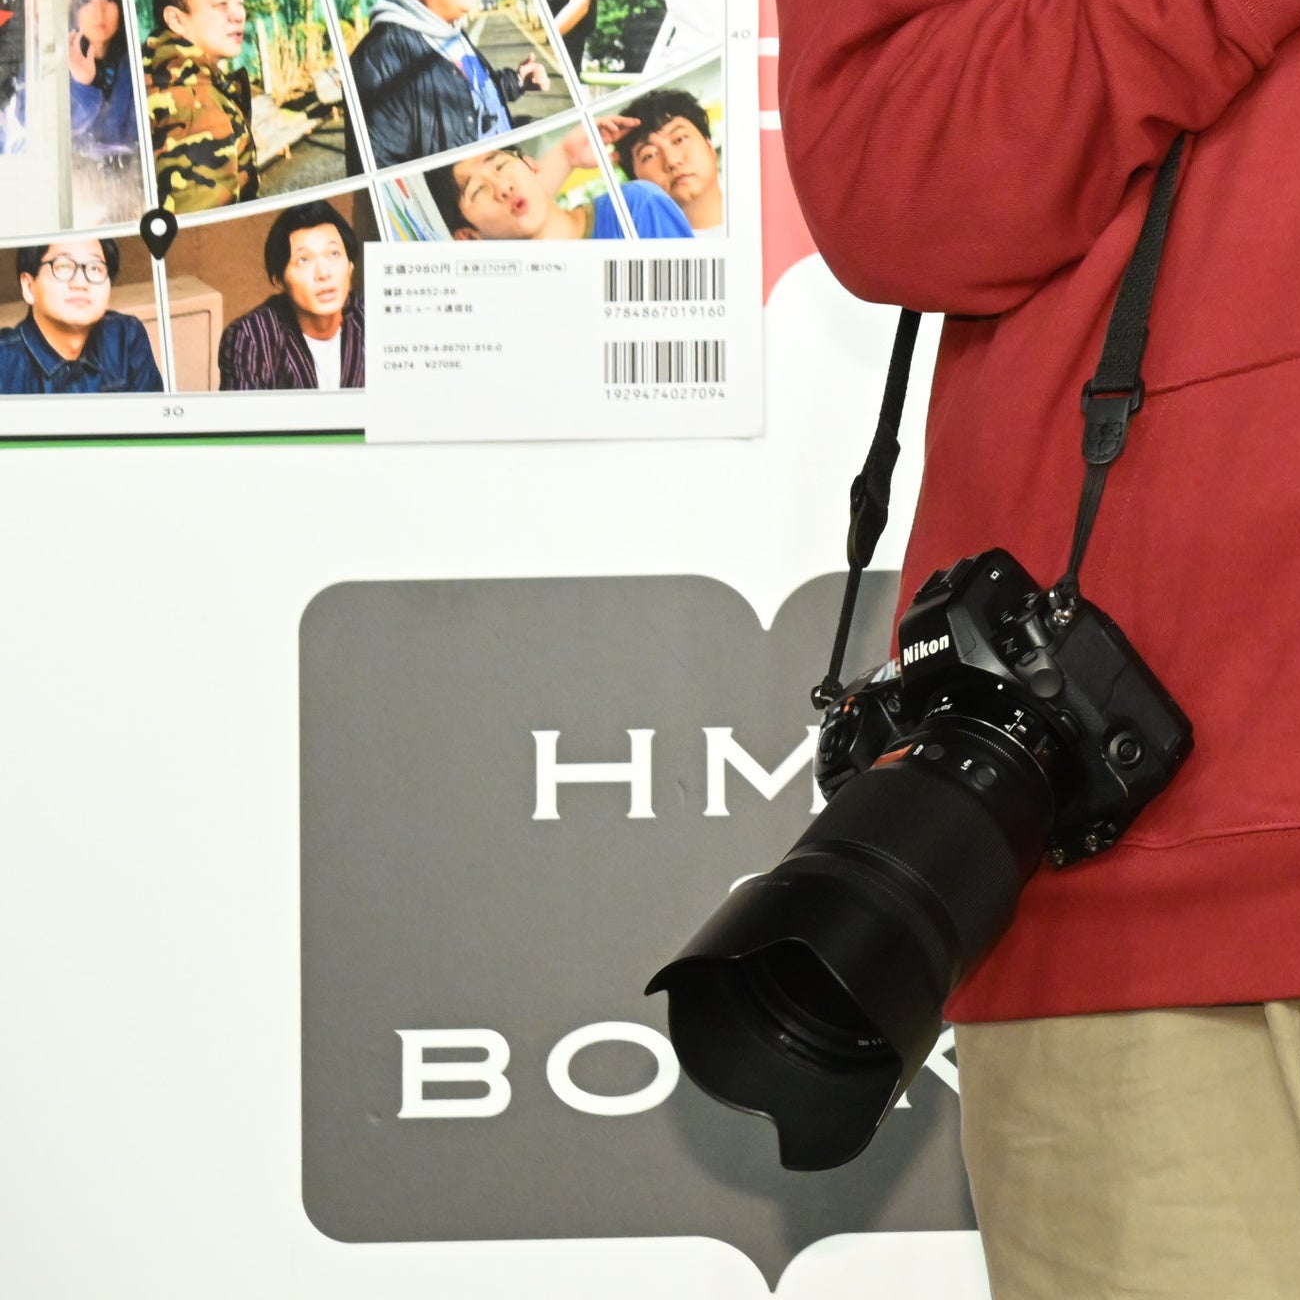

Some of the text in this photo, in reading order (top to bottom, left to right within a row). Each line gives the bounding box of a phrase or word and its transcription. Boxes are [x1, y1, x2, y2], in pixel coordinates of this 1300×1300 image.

[162, 405, 185, 417] 30
[903, 634, 950, 667] Nikon
[531, 725, 822, 820] HM
